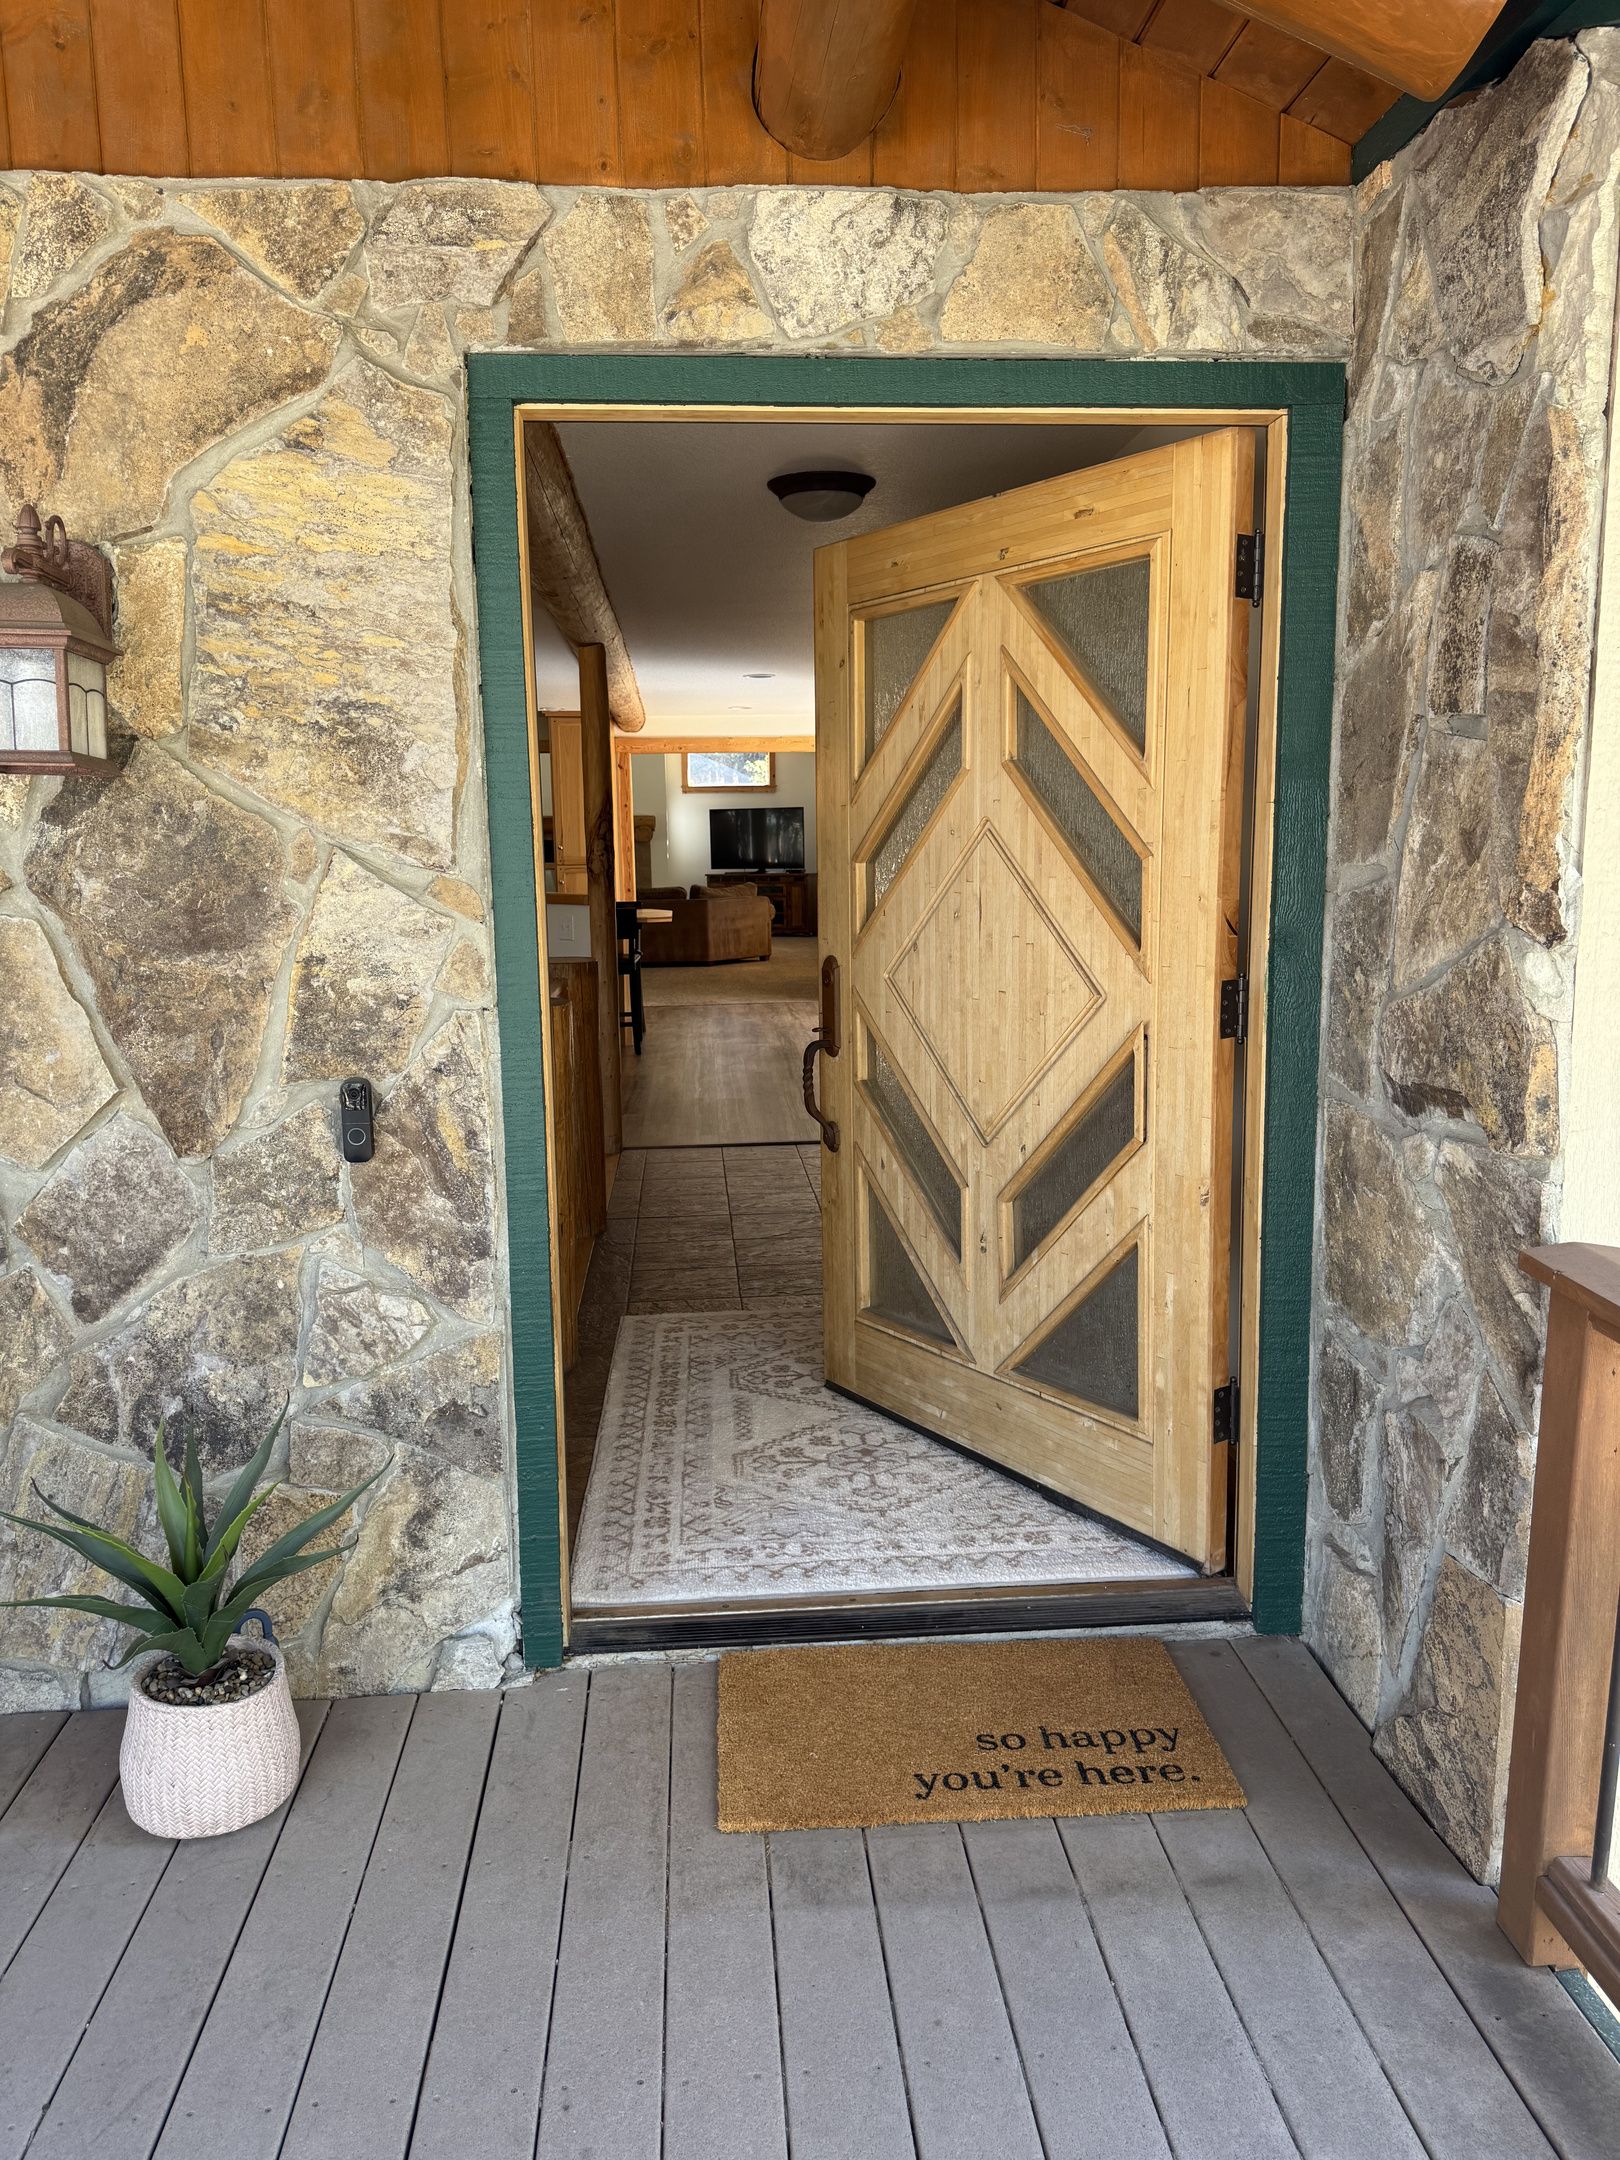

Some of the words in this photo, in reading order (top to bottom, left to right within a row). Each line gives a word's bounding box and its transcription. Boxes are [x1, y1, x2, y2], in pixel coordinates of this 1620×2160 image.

[976, 1731, 1027, 1750] so
[1038, 1726, 1179, 1755] happy
[914, 1764, 1063, 1800] you're
[1075, 1761, 1201, 1785] here.
